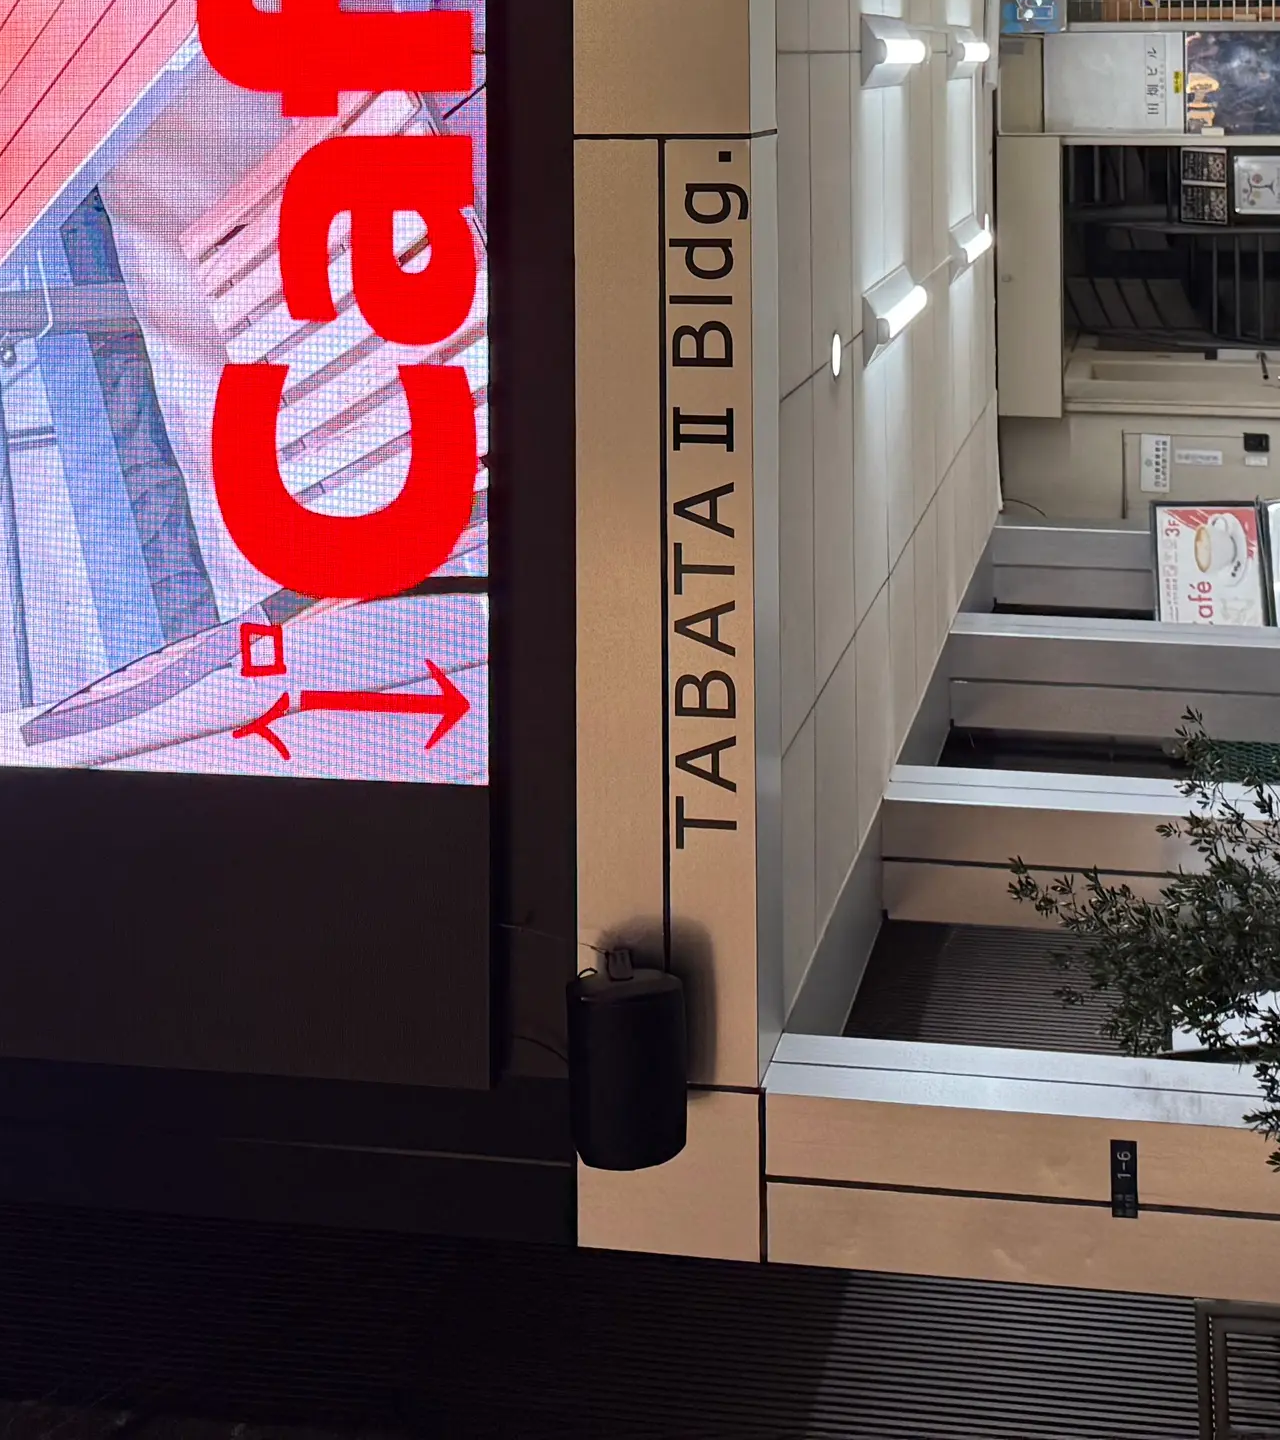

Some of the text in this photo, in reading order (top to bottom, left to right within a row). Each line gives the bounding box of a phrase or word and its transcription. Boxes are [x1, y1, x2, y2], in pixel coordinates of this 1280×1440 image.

[669, 149, 749, 369] Bldg.
[1165, 519, 1180, 537] 3F
[1187, 581, 1214, 625] afé
[232, 622, 291, 760] 入口
[673, 482, 738, 850] TABATA
[1116, 1151, 1132, 1180] 1-6
